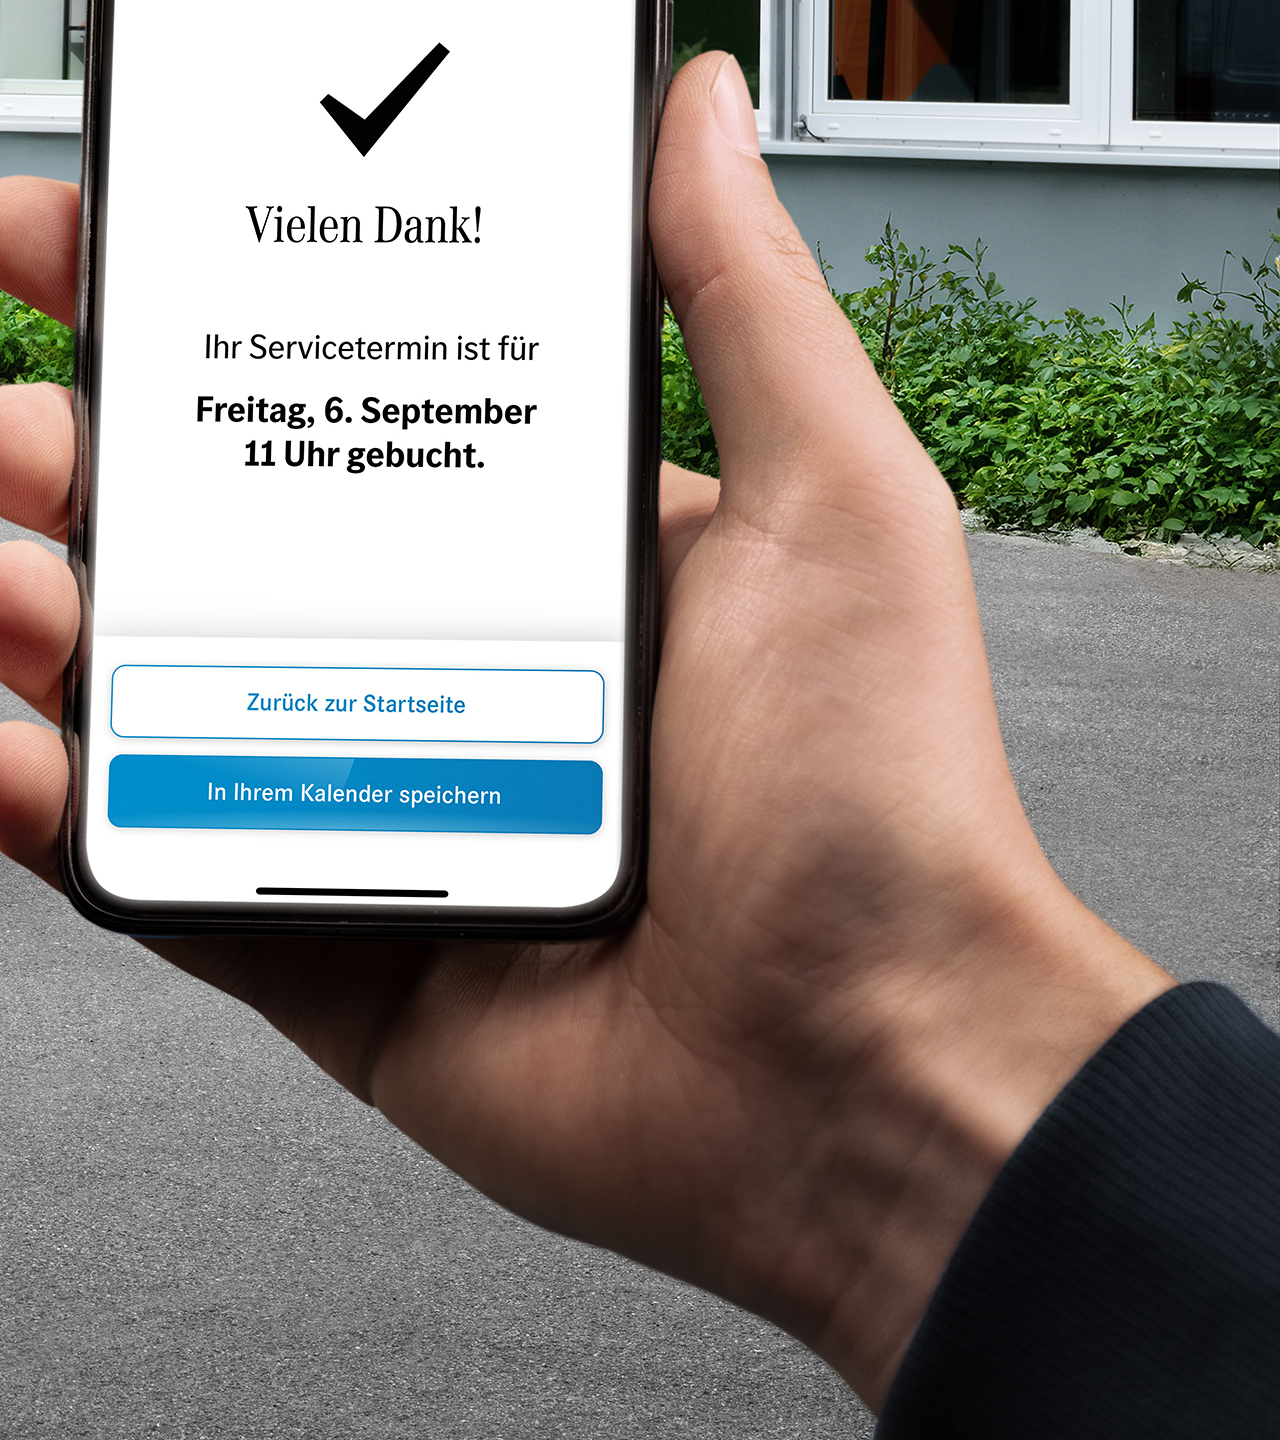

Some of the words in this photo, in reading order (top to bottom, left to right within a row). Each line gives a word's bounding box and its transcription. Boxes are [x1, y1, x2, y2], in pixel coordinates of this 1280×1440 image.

[245, 205, 363, 244] Vielen
[374, 205, 482, 244] Dank!
[205, 333, 242, 360] Ihr
[249, 333, 448, 361] Servicetermin
[457, 335, 491, 361] ist
[498, 334, 540, 362] für
[196, 395, 315, 430] Freitag,
[324, 395, 353, 424] 6.
[360, 396, 538, 431] September
[244, 439, 276, 467] 11
[284, 439, 341, 468] Uhr
[346, 440, 485, 475] gebucht.
[246, 692, 319, 712] Zurück
[325, 698, 358, 713] zur
[363, 693, 466, 714] Startseite
[208, 781, 226, 801] In
[234, 781, 293, 802] Ihrem
[301, 782, 393, 804] Kalender
[399, 785, 502, 809] speichern
